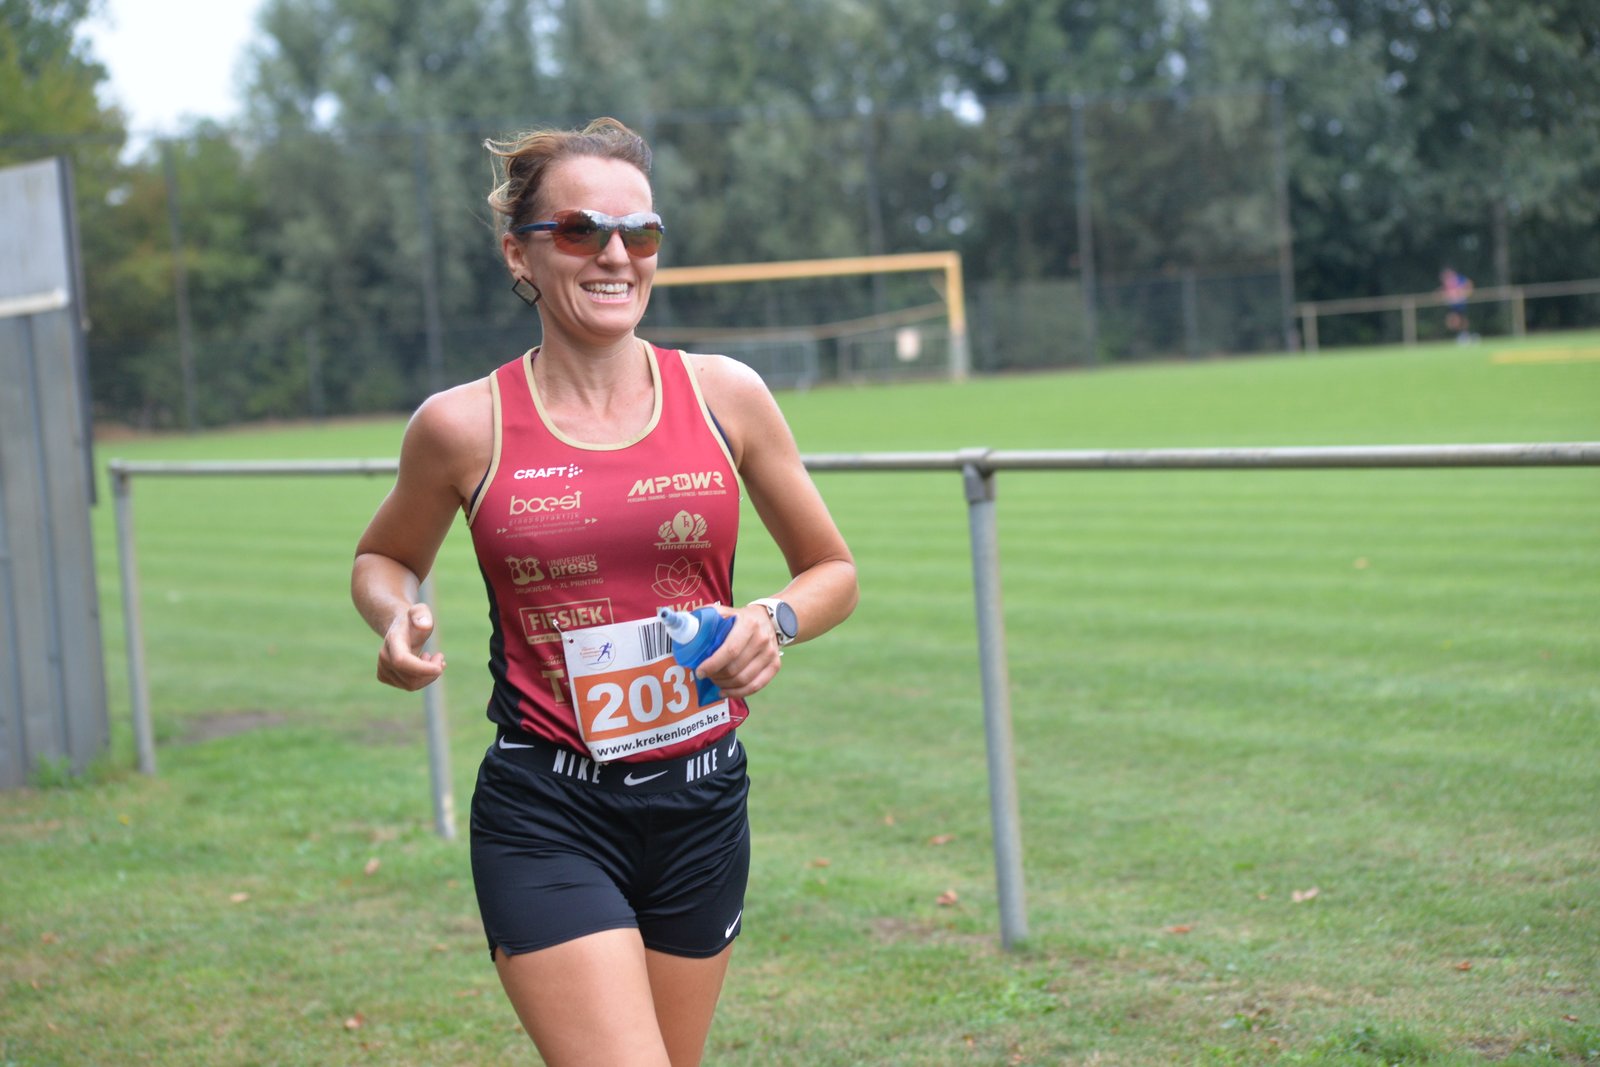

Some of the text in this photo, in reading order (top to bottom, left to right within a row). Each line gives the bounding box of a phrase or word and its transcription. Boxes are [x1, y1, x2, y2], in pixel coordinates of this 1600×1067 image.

[513, 466, 567, 480] CRAFT
[627, 471, 725, 497] MPOWR
[547, 554, 597, 567] UNIVERSITY
[549, 561, 598, 580] press
[570, 577, 604, 587] PRINTING
[587, 665, 695, 733] 203
[597, 713, 719, 757] www.krekenlopers.be
[553, 749, 601, 784] NIKE
[686, 748, 717, 783] NIKE
